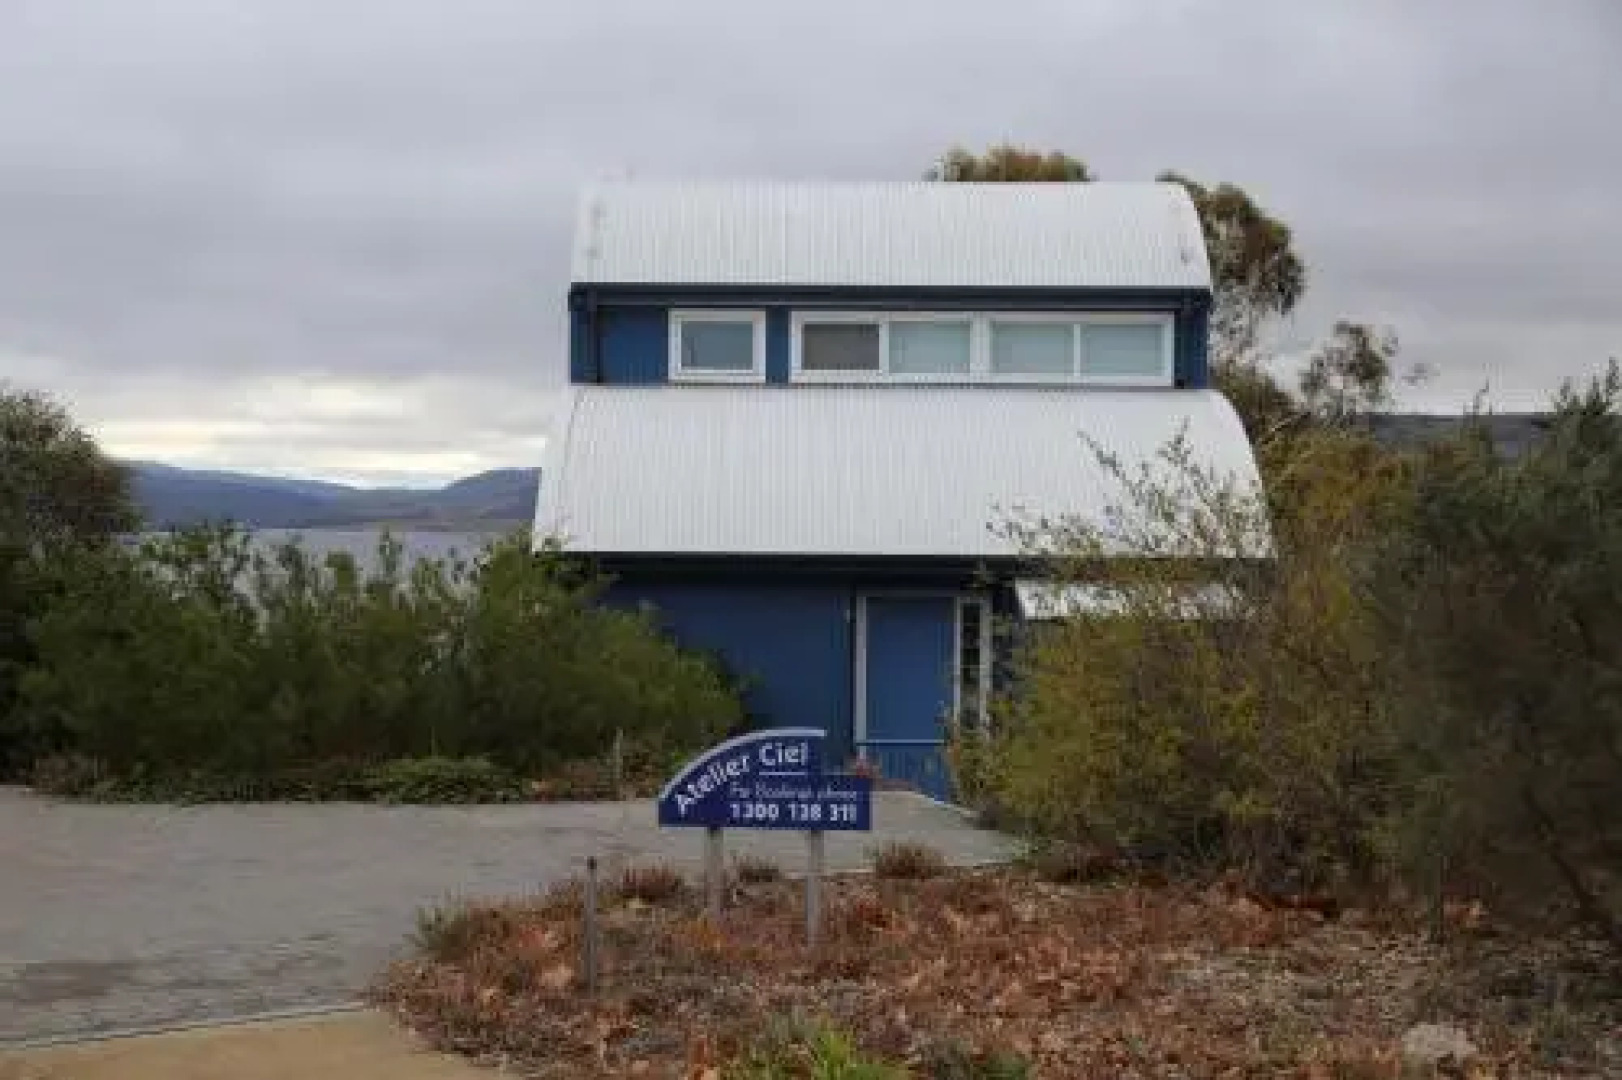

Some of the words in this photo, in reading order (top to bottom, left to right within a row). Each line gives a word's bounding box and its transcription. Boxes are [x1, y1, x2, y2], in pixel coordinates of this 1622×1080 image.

[676, 755, 749, 816] Atelier
[758, 742, 808, 766] Ciel
[729, 803, 780, 820] 1300
